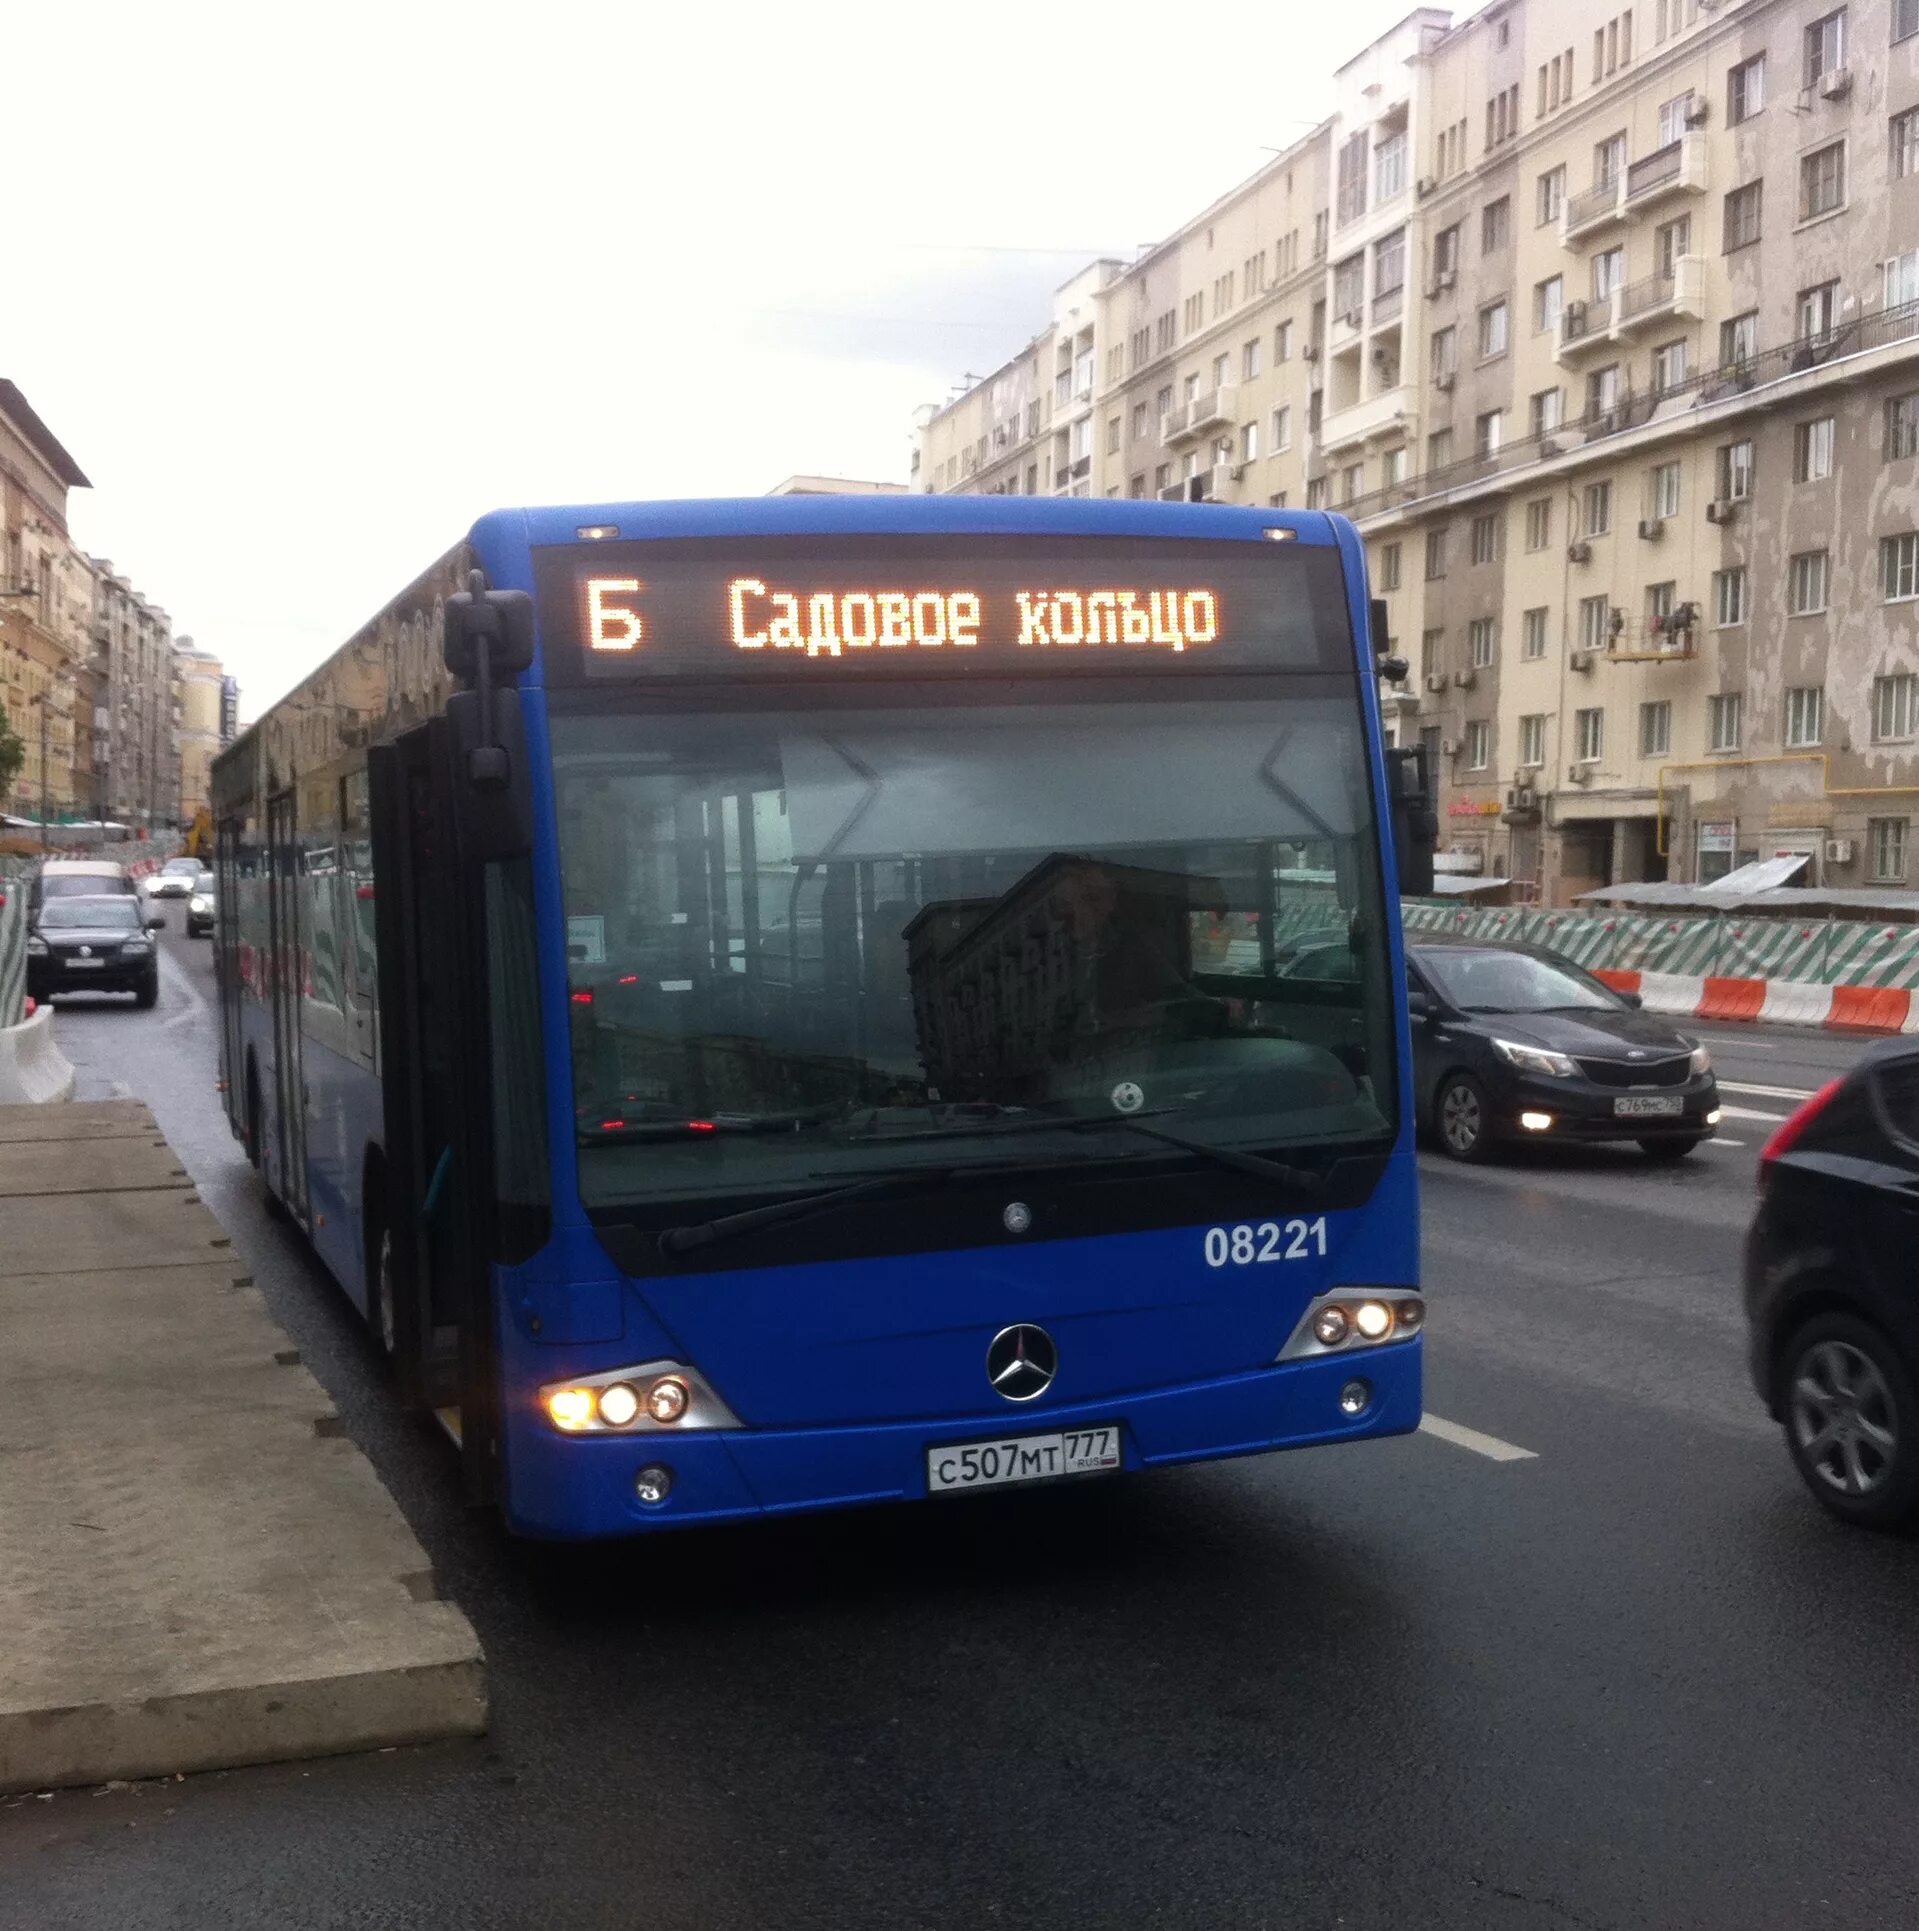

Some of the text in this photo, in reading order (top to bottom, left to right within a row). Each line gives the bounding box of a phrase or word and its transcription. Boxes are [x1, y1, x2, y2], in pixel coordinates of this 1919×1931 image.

[587, 579, 1217, 657] Б Садовое кольцо
[1205, 1216, 1327, 1267] 08221
[1065, 1430, 1111, 1459] 777
[1078, 1458, 1099, 1467] RUS
